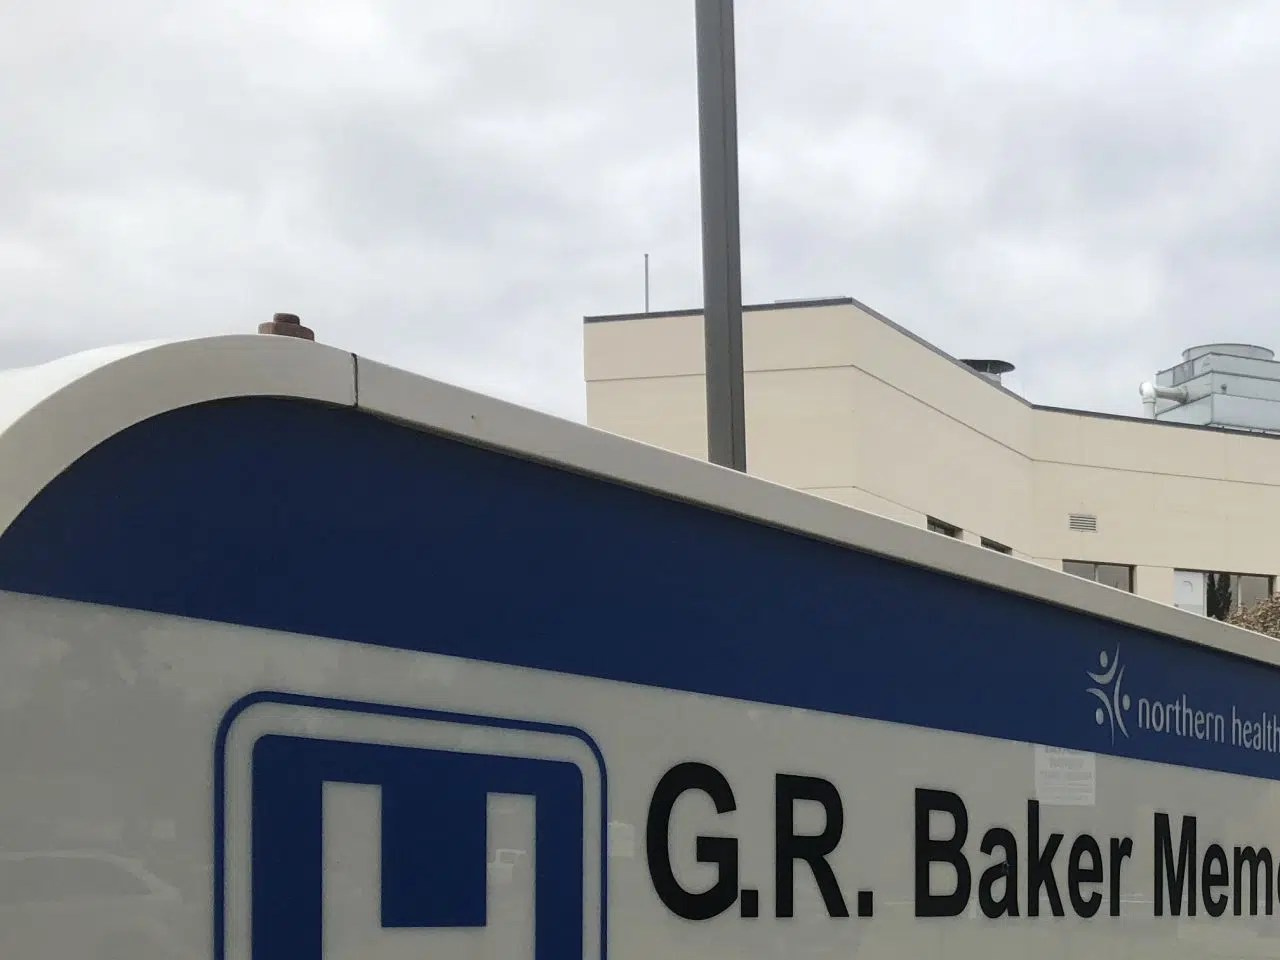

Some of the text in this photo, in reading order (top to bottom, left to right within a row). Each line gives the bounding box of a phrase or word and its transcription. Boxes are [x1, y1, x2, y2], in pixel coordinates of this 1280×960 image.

[1138, 693, 1225, 744] northern
[646, 761, 874, 921] G.R.
[914, 787, 1133, 919] Baker
